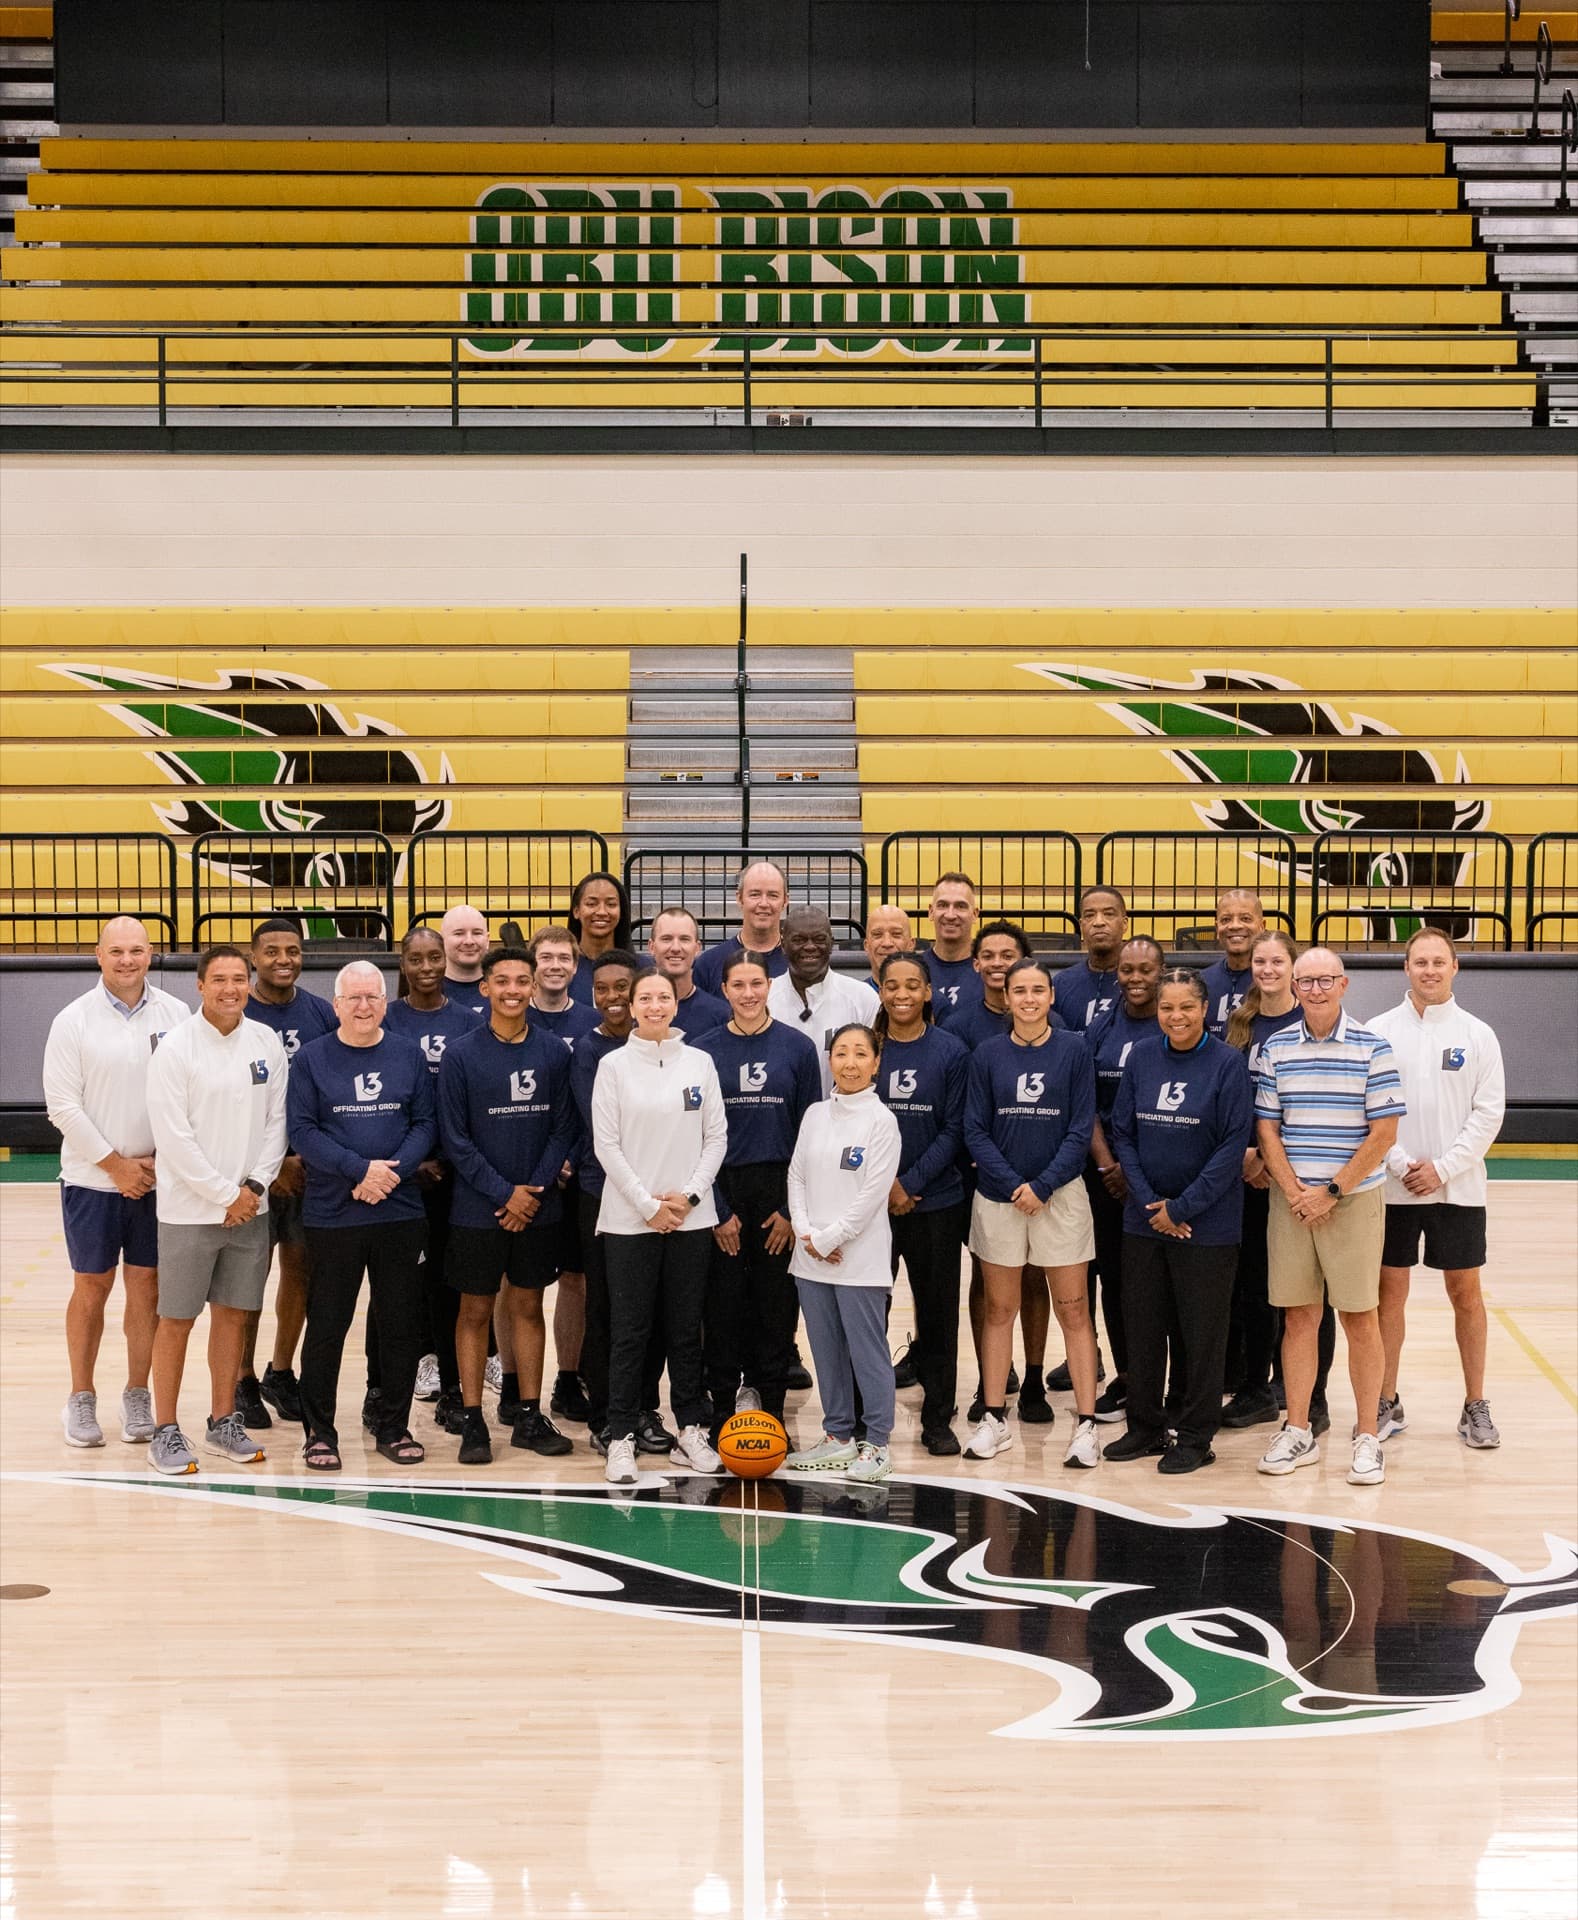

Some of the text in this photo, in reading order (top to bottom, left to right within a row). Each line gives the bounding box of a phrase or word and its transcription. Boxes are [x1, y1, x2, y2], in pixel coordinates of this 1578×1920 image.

[694, 185, 1035, 358] BISON
[249, 1059, 270, 1085] L3
[1441, 1047, 1466, 1072] L3
[353, 1072, 383, 1101] L3
[510, 1069, 537, 1101] L3
[740, 1061, 768, 1092] L3
[888, 1069, 917, 1099] L3
[1016, 1072, 1045, 1103] L3
[333, 1104, 377, 1113] OFFICIATING
[683, 1085, 703, 1111] L3
[1156, 1081, 1188, 1111] L3
[1175, 1116, 1200, 1125] GROUP
[840, 1146, 866, 1172] L3
[730, 1417, 777, 1432] Wilson
[735, 1439, 771, 1450] NCAA
